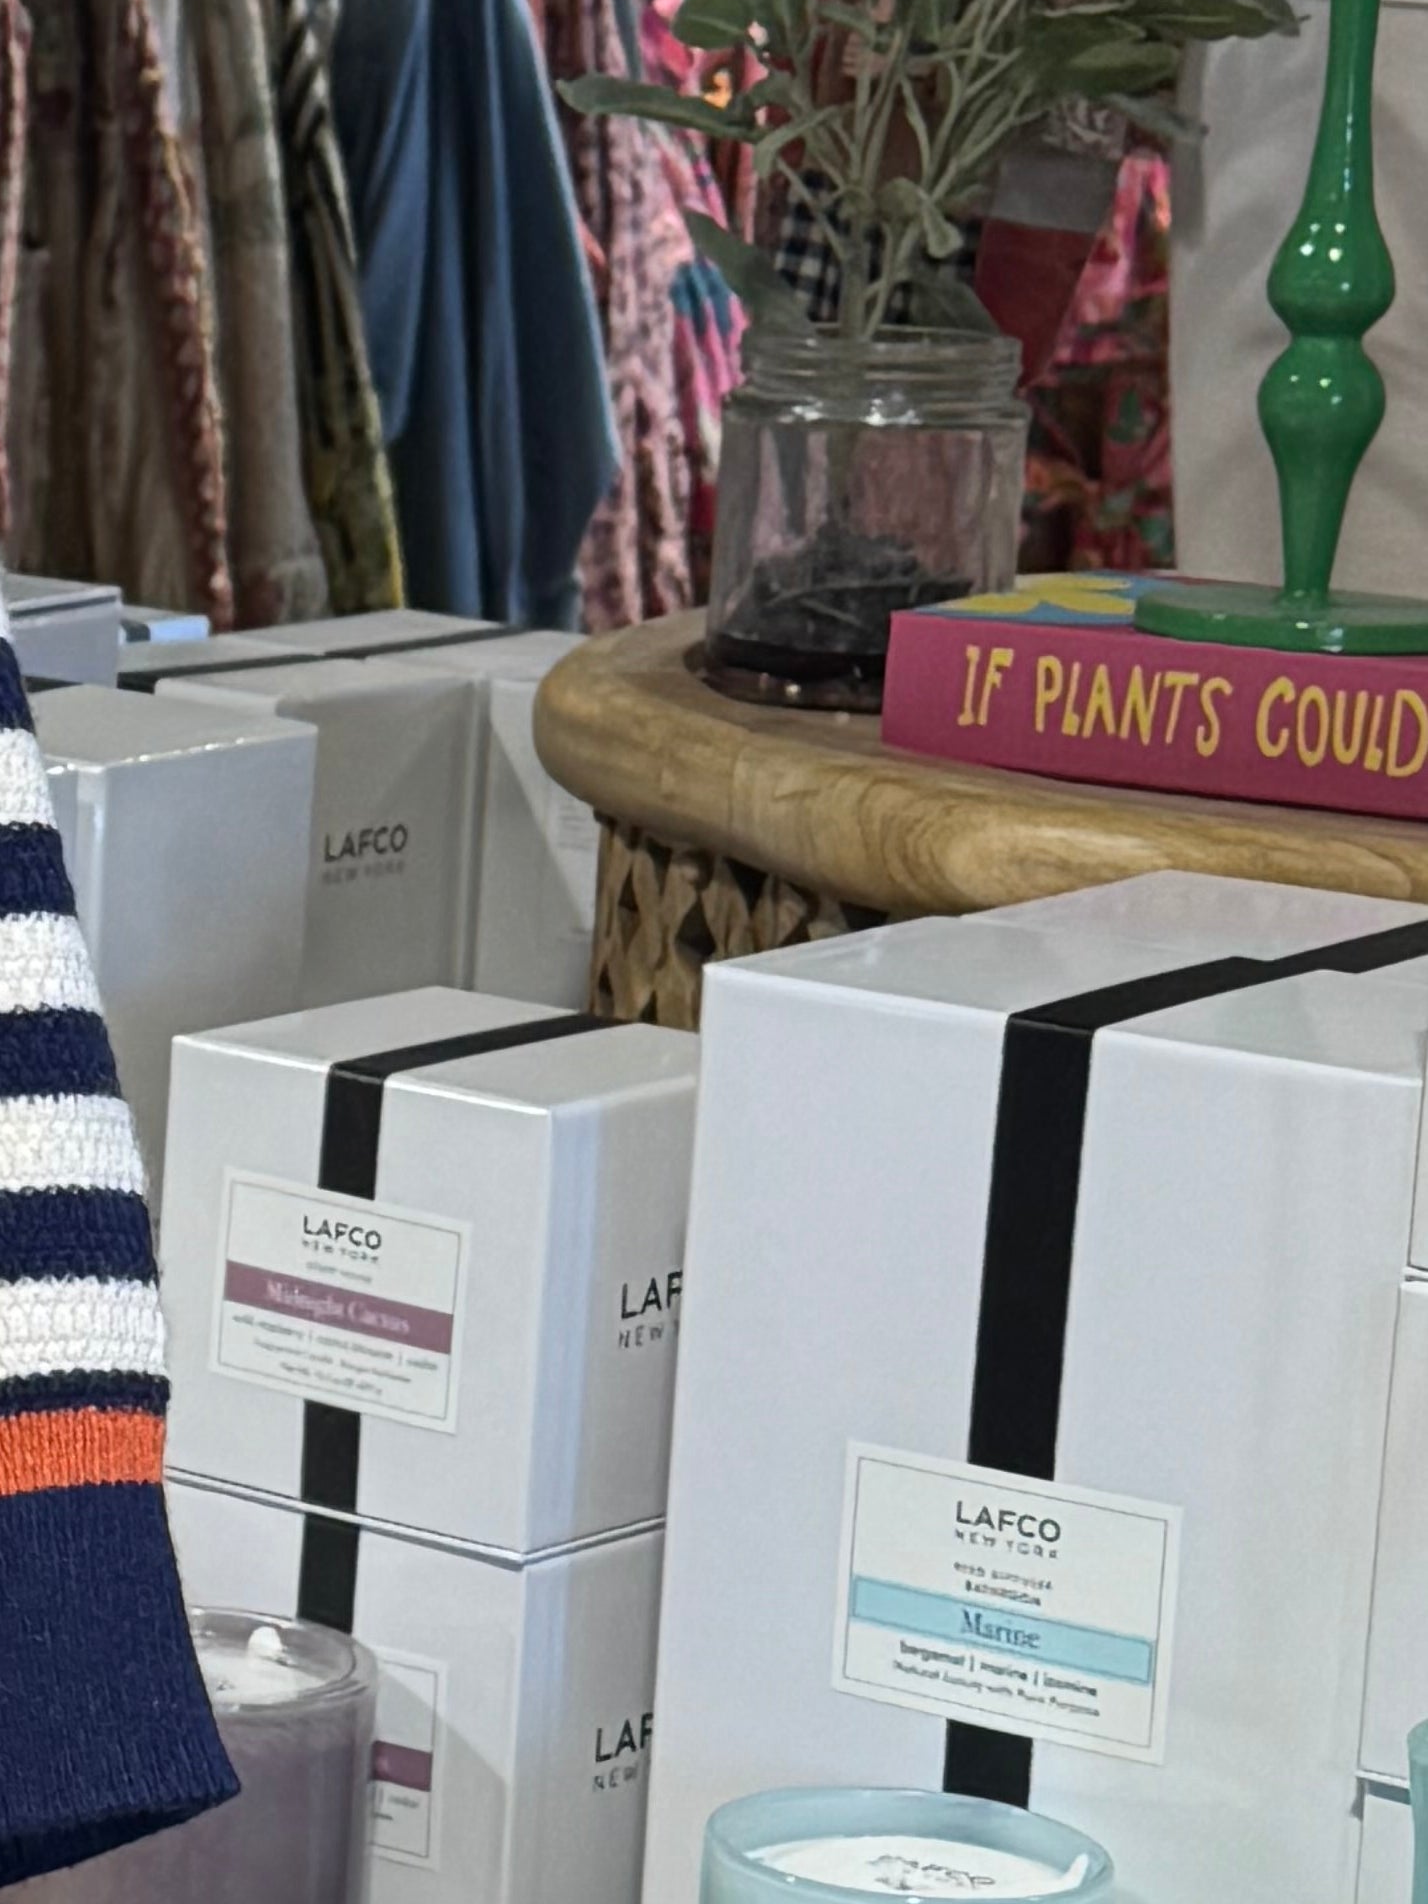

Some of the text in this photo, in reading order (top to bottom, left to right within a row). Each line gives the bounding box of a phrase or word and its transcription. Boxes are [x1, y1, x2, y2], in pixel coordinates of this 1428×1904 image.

[957, 644, 1428, 778] IF PLANTS COULD
[323, 823, 408, 863] LAFCO
[302, 1214, 383, 1251] LAFCO
[954, 1499, 1062, 1543] LAFCO
[959, 1608, 1042, 1650] Marine
